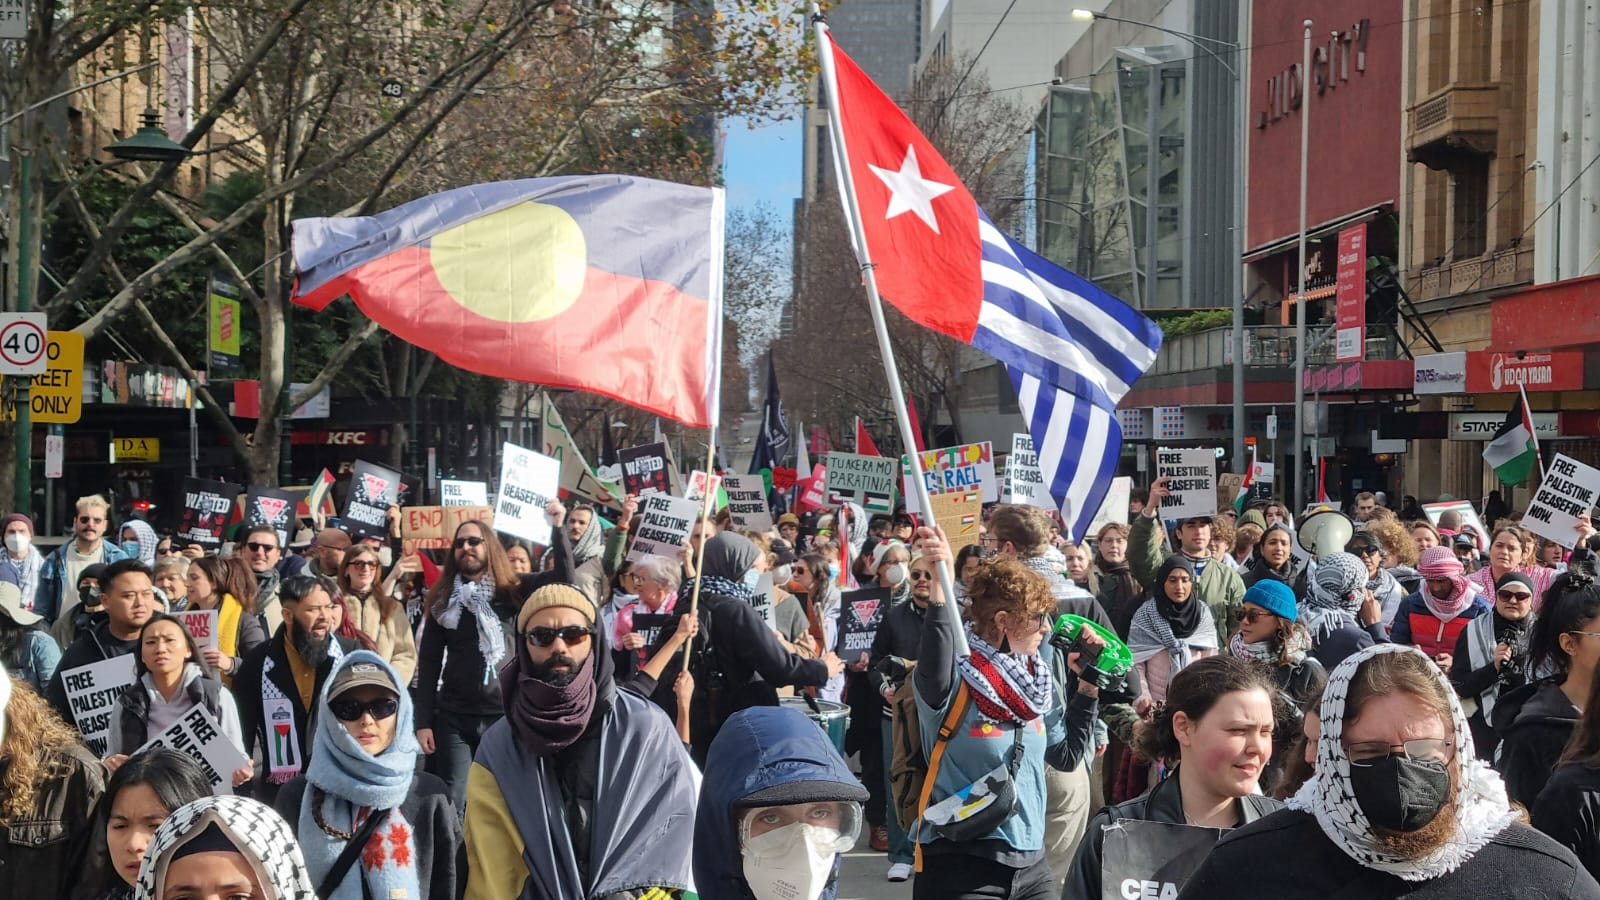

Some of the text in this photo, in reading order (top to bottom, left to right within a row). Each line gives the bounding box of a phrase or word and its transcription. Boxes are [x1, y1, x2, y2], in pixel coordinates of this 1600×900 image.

[1313, 18, 1370, 97] CITY
[383, 83, 402, 96] 48
[3, 332, 40, 354] 40
[1505, 365, 1552, 385] UDON YASAN
[31, 395, 72, 414] ONLY
[326, 432, 366, 445] KFC
[1159, 453, 1182, 464] FREE
[1552, 458, 1578, 478] FREE
[829, 471, 892, 492] PARATINIA
[1160, 466, 1212, 477] PALESTINE,
[444, 484, 462, 496] FREE
[724, 478, 741, 488] FREE
[1544, 474, 1593, 506] PALESTINE,
[500, 500, 522, 519] NOW.
[648, 497, 672, 512] FREE
[1161, 495, 1185, 508] NOW.
[409, 509, 443, 531] END
[643, 512, 689, 533] PALESTINE,
[1528, 504, 1553, 524] NOW.
[638, 527, 685, 547] CEASEFIRE
[632, 541, 655, 555] NOW.
[845, 631, 866, 641] DOWN
[65, 670, 95, 693] FREE
[184, 709, 218, 746] FREE
[1120, 878, 1180, 900] CEA
